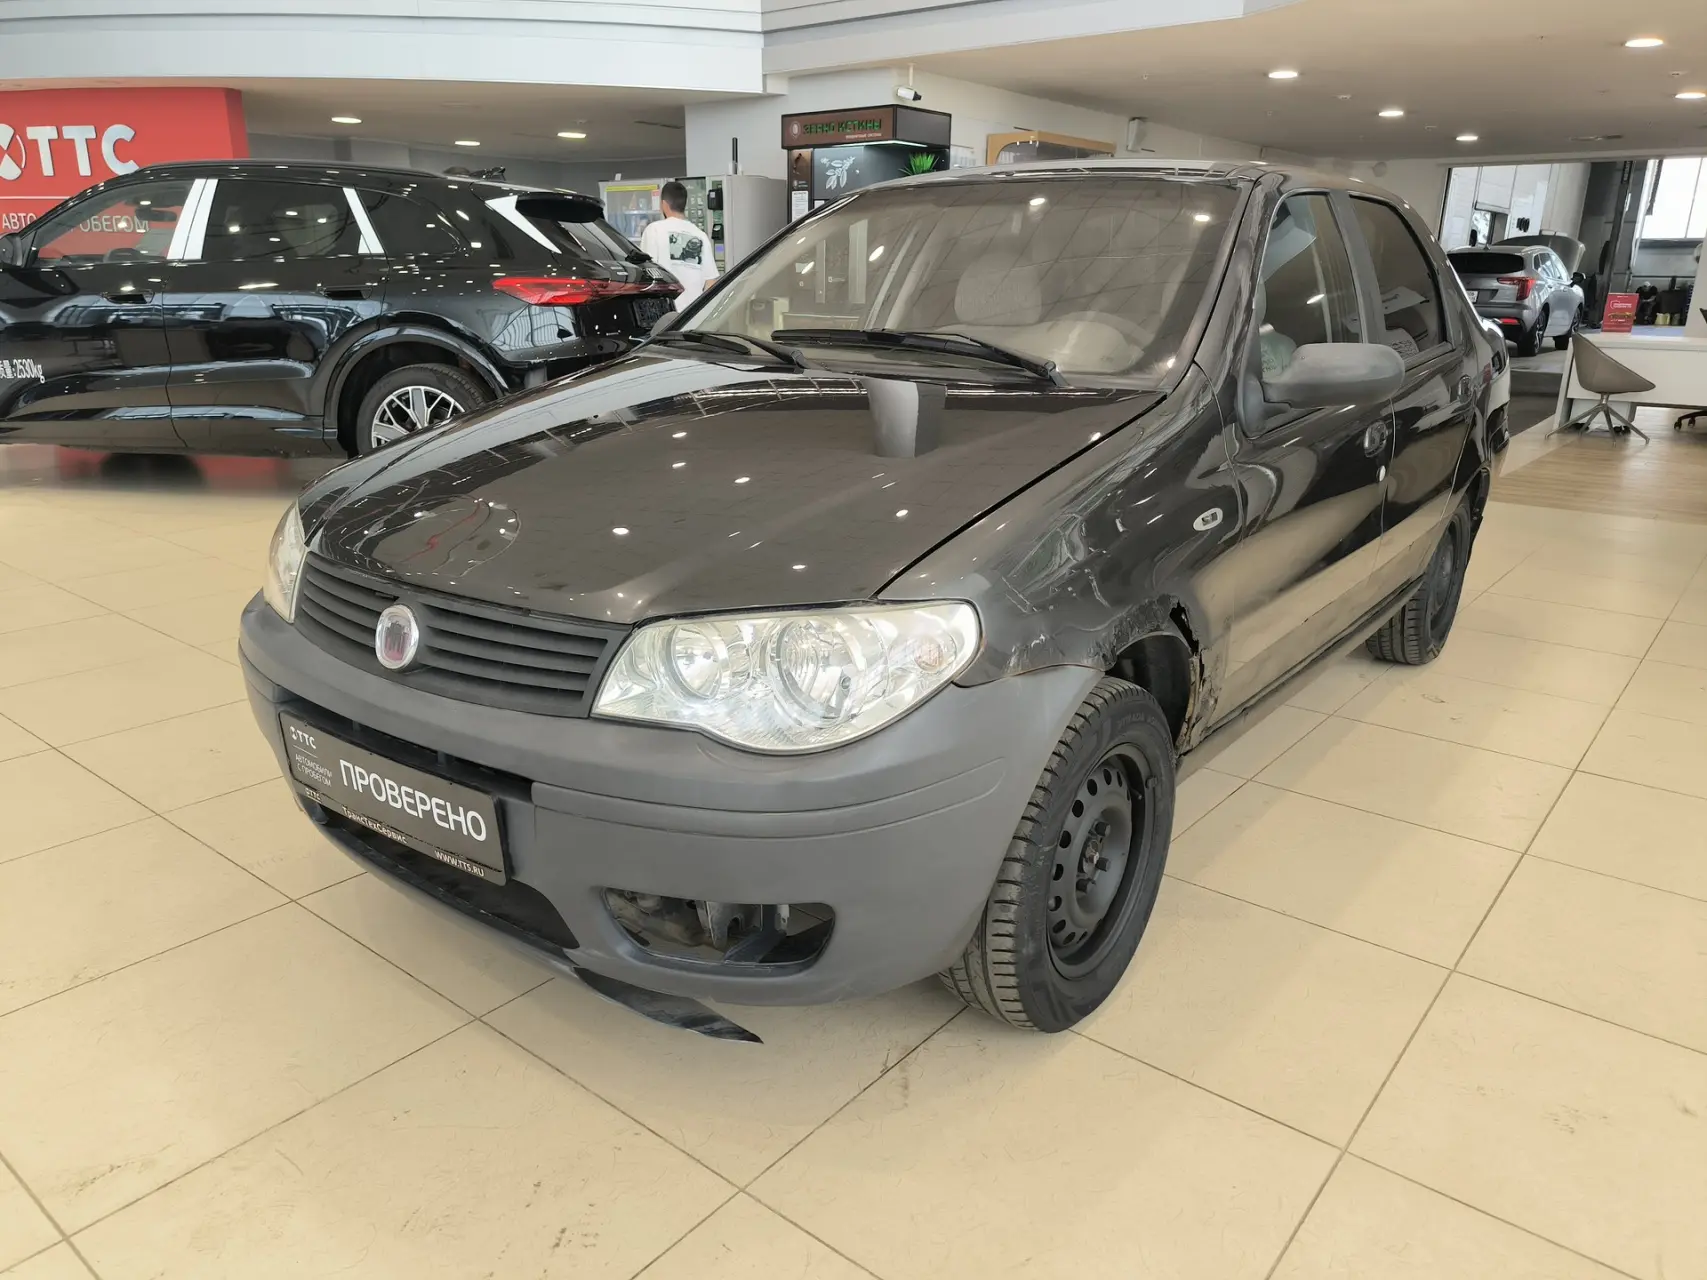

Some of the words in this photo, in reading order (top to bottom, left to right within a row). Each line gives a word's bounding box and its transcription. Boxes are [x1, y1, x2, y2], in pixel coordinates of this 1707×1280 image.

[26, 123, 139, 177] ТТС
[79, 215, 150, 232] ОБЕГОМ
[296, 729, 317, 750] ТТС
[339, 759, 487, 842] ПРОВЕРЕНО
[434, 849, 485, 877] WWW.TTS.RU
